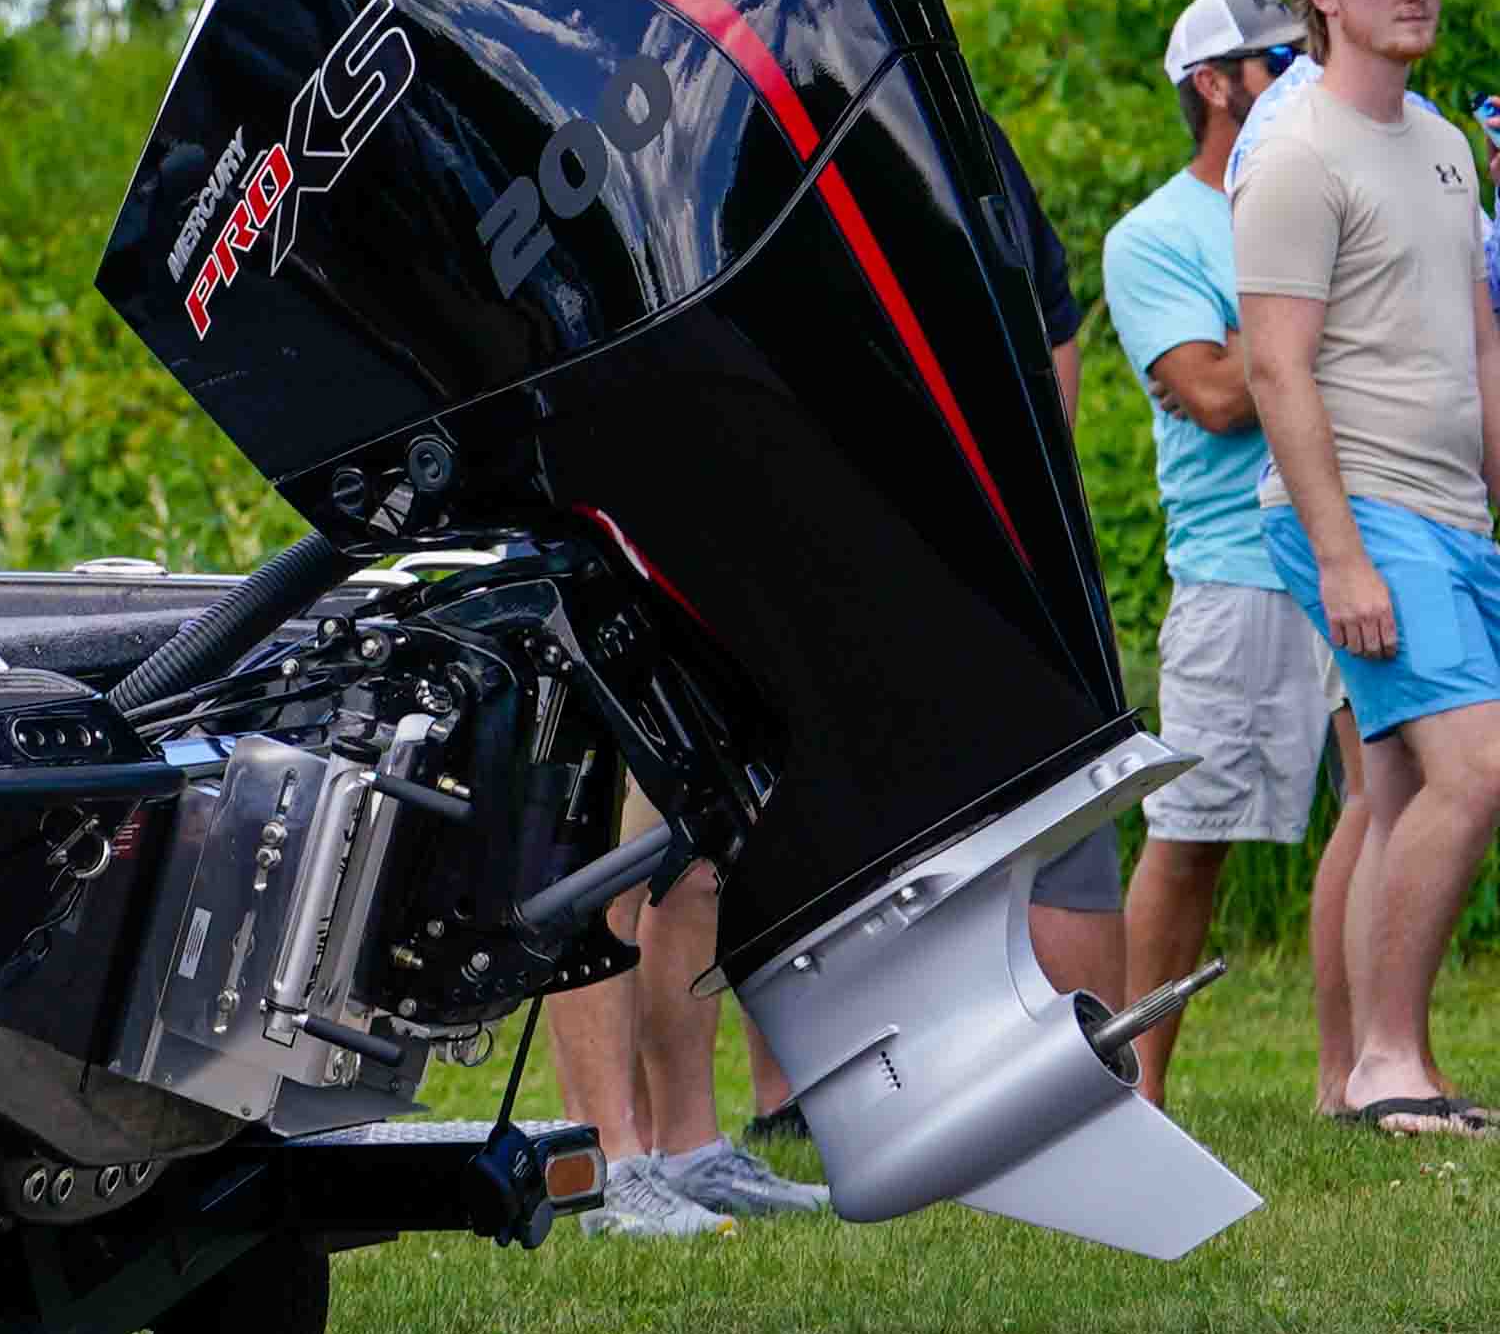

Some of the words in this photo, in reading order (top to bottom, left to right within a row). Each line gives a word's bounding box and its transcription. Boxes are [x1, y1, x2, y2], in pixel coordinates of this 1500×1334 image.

[167, 125, 247, 283] MERCURY
[185, 143, 294, 342] PRO
[476, 58, 673, 300] 200
